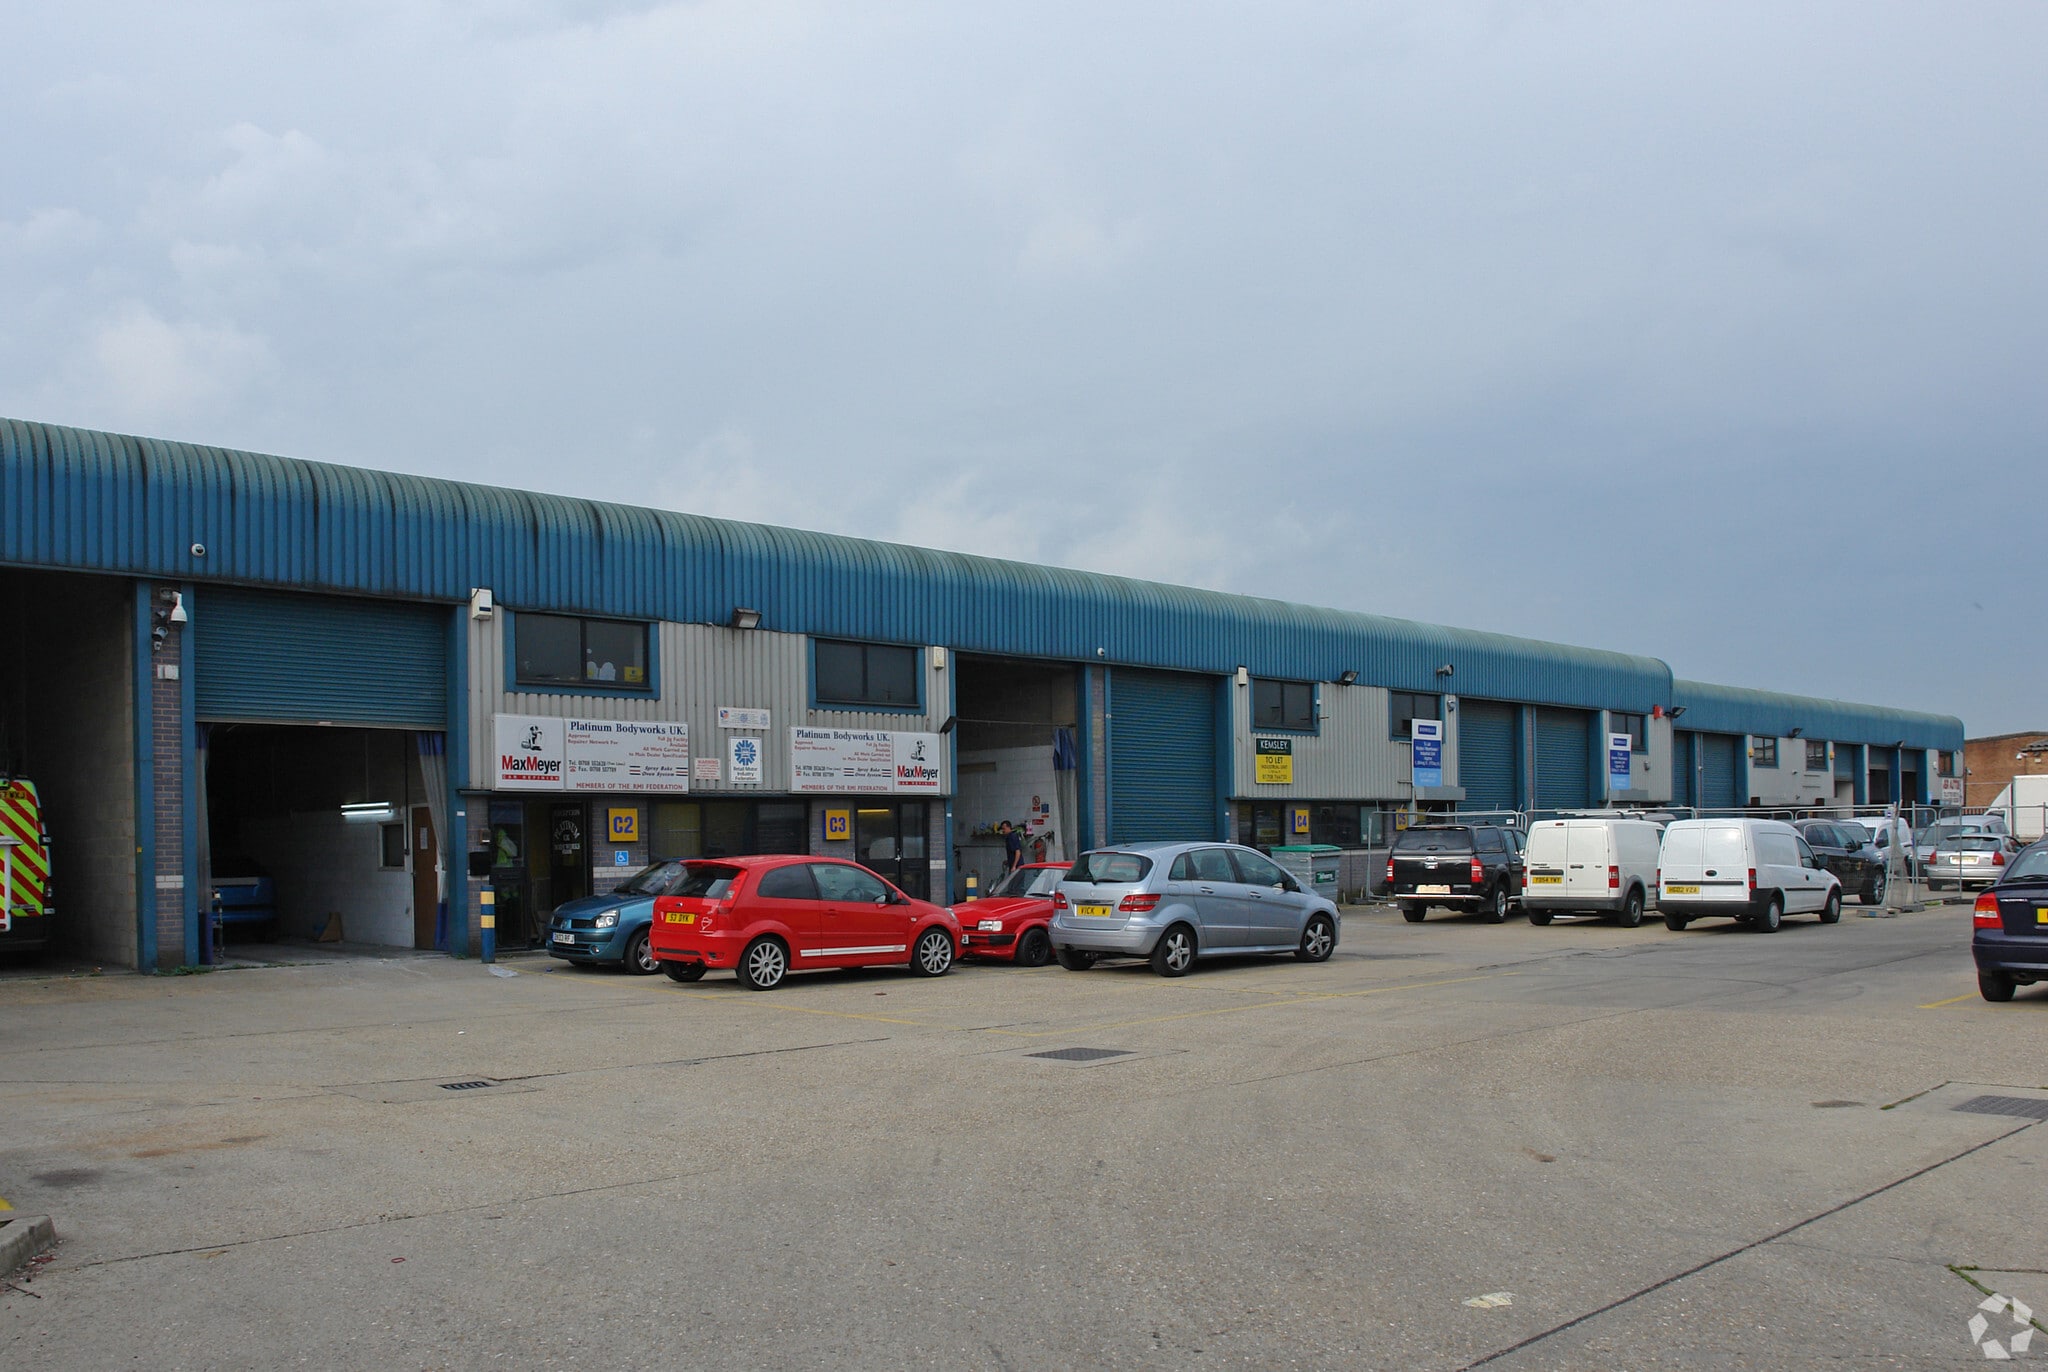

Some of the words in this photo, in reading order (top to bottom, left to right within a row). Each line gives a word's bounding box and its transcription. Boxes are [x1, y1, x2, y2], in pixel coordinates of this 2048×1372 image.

[571, 721, 612, 732] Platinum
[616, 724, 666, 735] Bodyworks
[670, 726, 686, 736] UK.
[796, 729, 830, 739] Platinum
[834, 731, 874, 741] Bodyworks
[877, 733, 890, 741] UK.
[1260, 740, 1288, 750] KEMSLEY
[502, 755, 561, 774] MaxMeyer
[1265, 756, 1273, 764] TO
[1275, 756, 1283, 764] LET
[897, 765, 938, 780] MaxMeyer
[613, 816, 633, 833] C2
[830, 817, 846, 832] C3
[1297, 815, 1307, 827] C4
